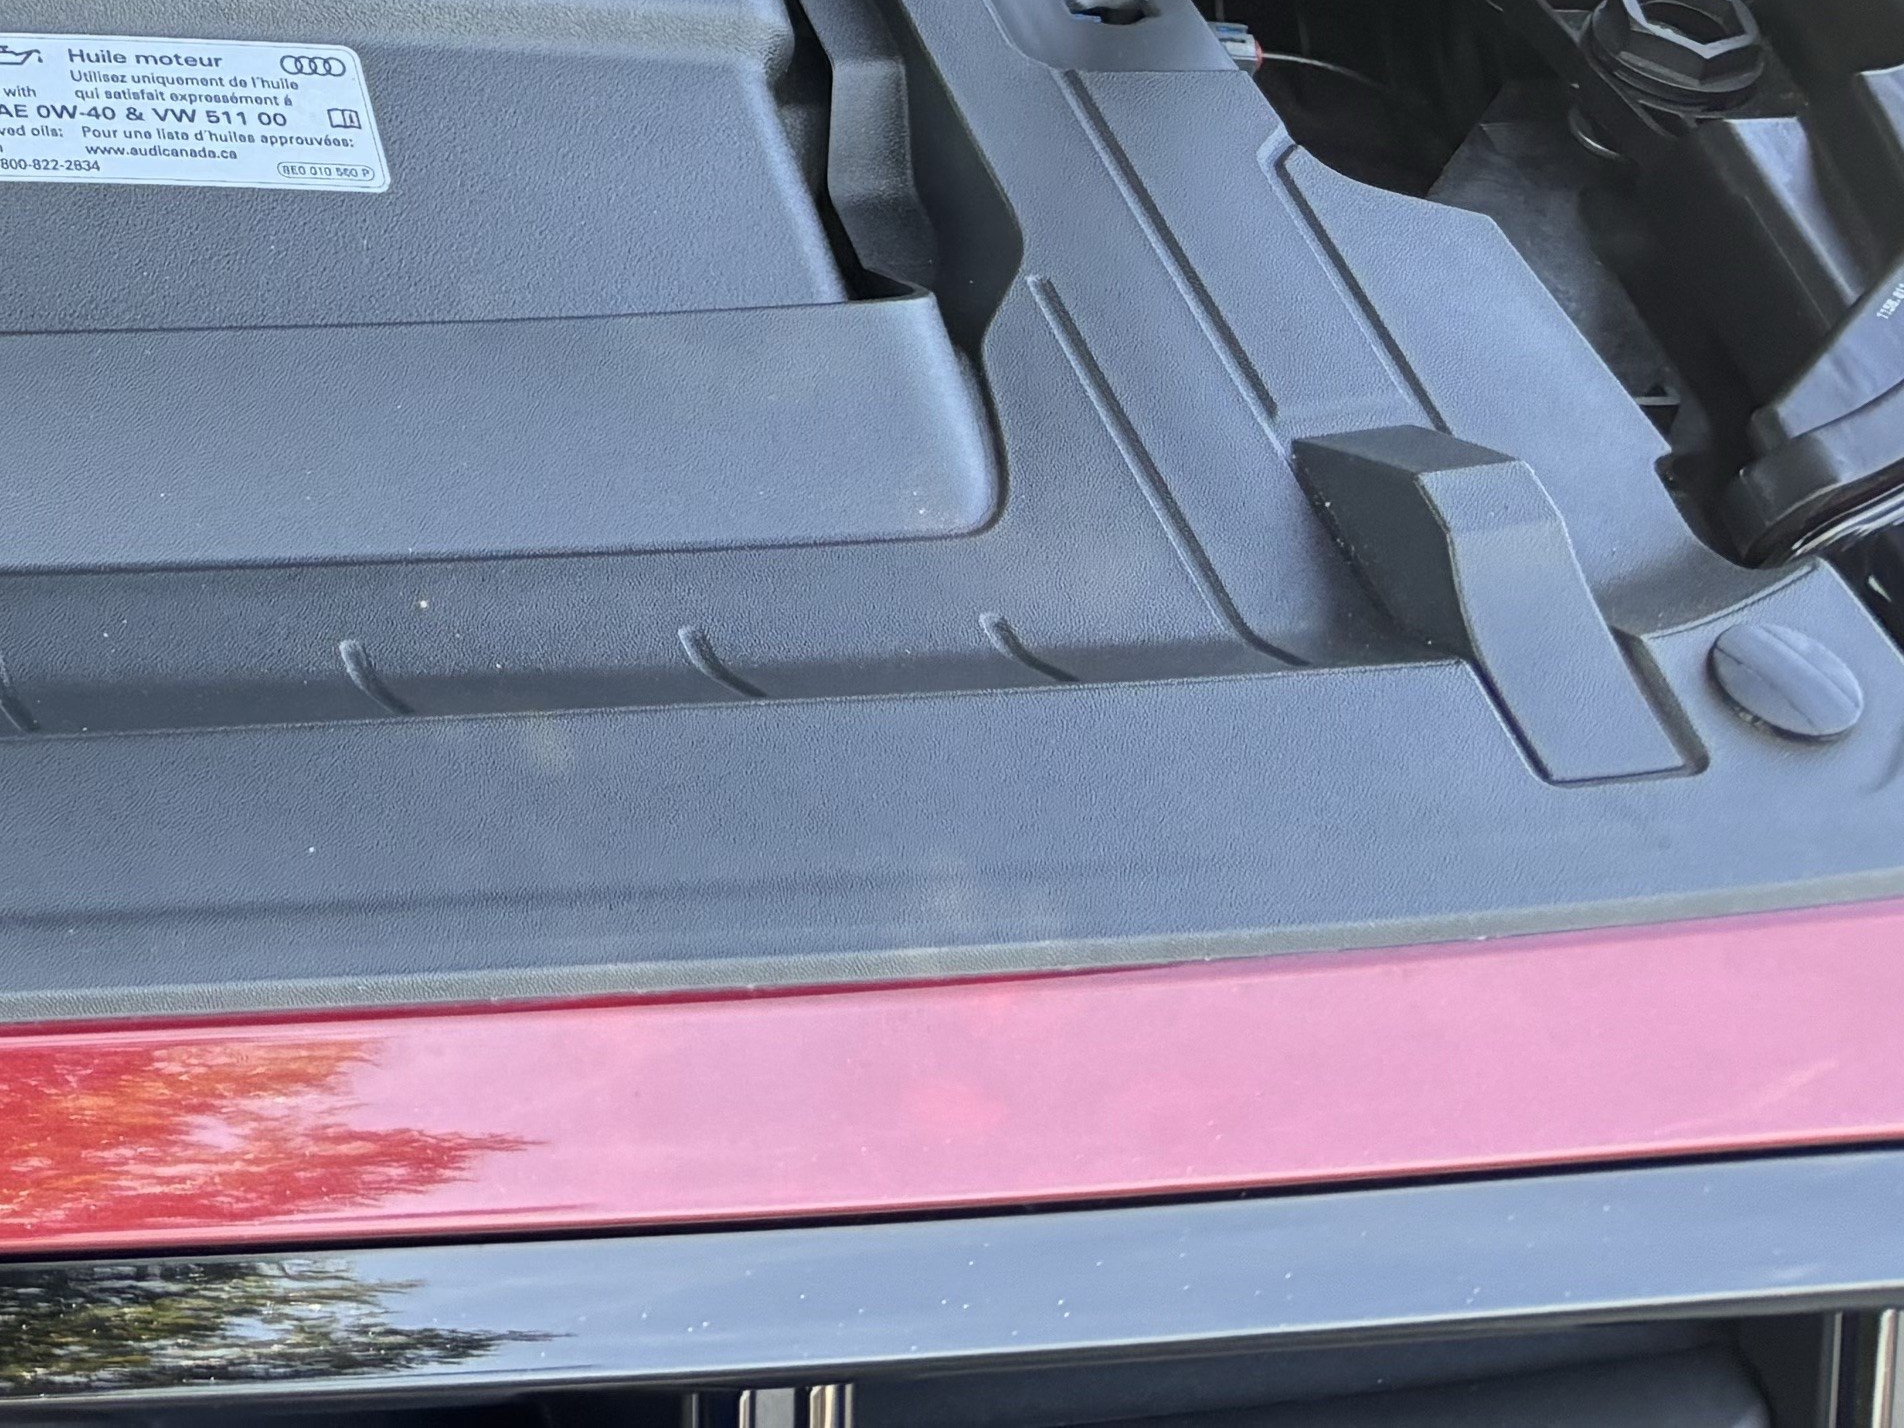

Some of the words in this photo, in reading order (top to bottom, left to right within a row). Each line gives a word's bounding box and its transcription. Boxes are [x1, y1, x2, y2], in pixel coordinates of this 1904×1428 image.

[67, 48, 127, 64] Huile
[135, 52, 223, 68] moteur
[70, 70, 127, 84] Utilisez
[130, 72, 225, 88] uniquement
[228, 76, 247, 88] de
[4, 85, 37, 97] with
[74, 87, 100, 101] qui
[104, 87, 166, 101] satisfait
[170, 91, 279, 106] expressément
[37, 104, 116, 120] 0W-40
[125, 106, 145, 121] &
[152, 107, 197, 123] VW
[206, 109, 247, 125] 511
[257, 111, 287, 127] 00
[31, 125, 64, 137] oils:
[82, 126, 117, 139] Pour
[123, 129, 152, 140] une
[157, 128, 189, 141] liste
[85, 145, 237, 160] www.audicanada.ca
